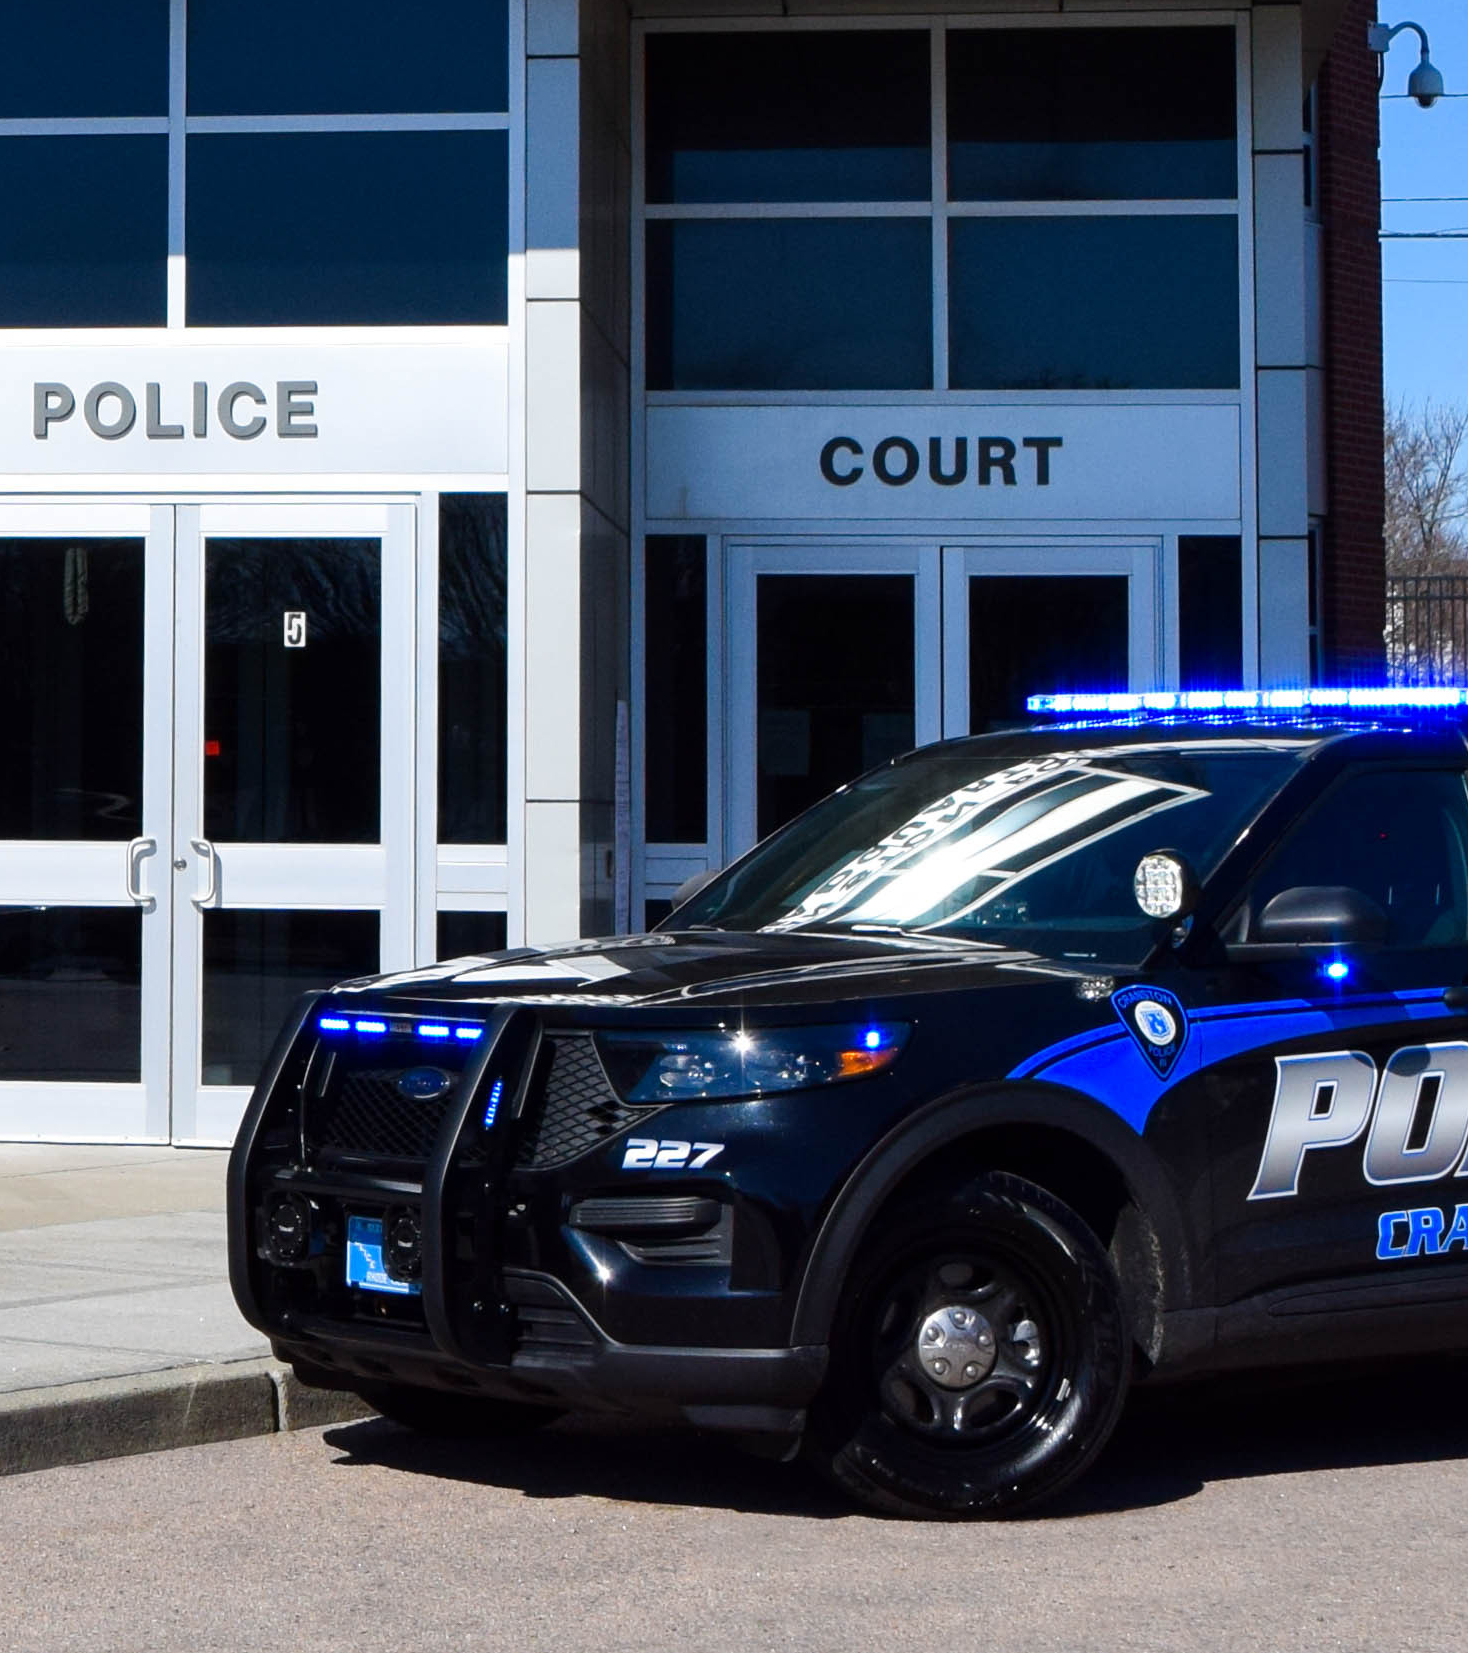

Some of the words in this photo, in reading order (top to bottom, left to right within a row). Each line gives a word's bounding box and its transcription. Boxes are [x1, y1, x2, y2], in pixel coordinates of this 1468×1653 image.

[33, 381, 318, 441] POLICE
[820, 436, 1063, 486] COURT
[622, 1138, 725, 1169] 227
